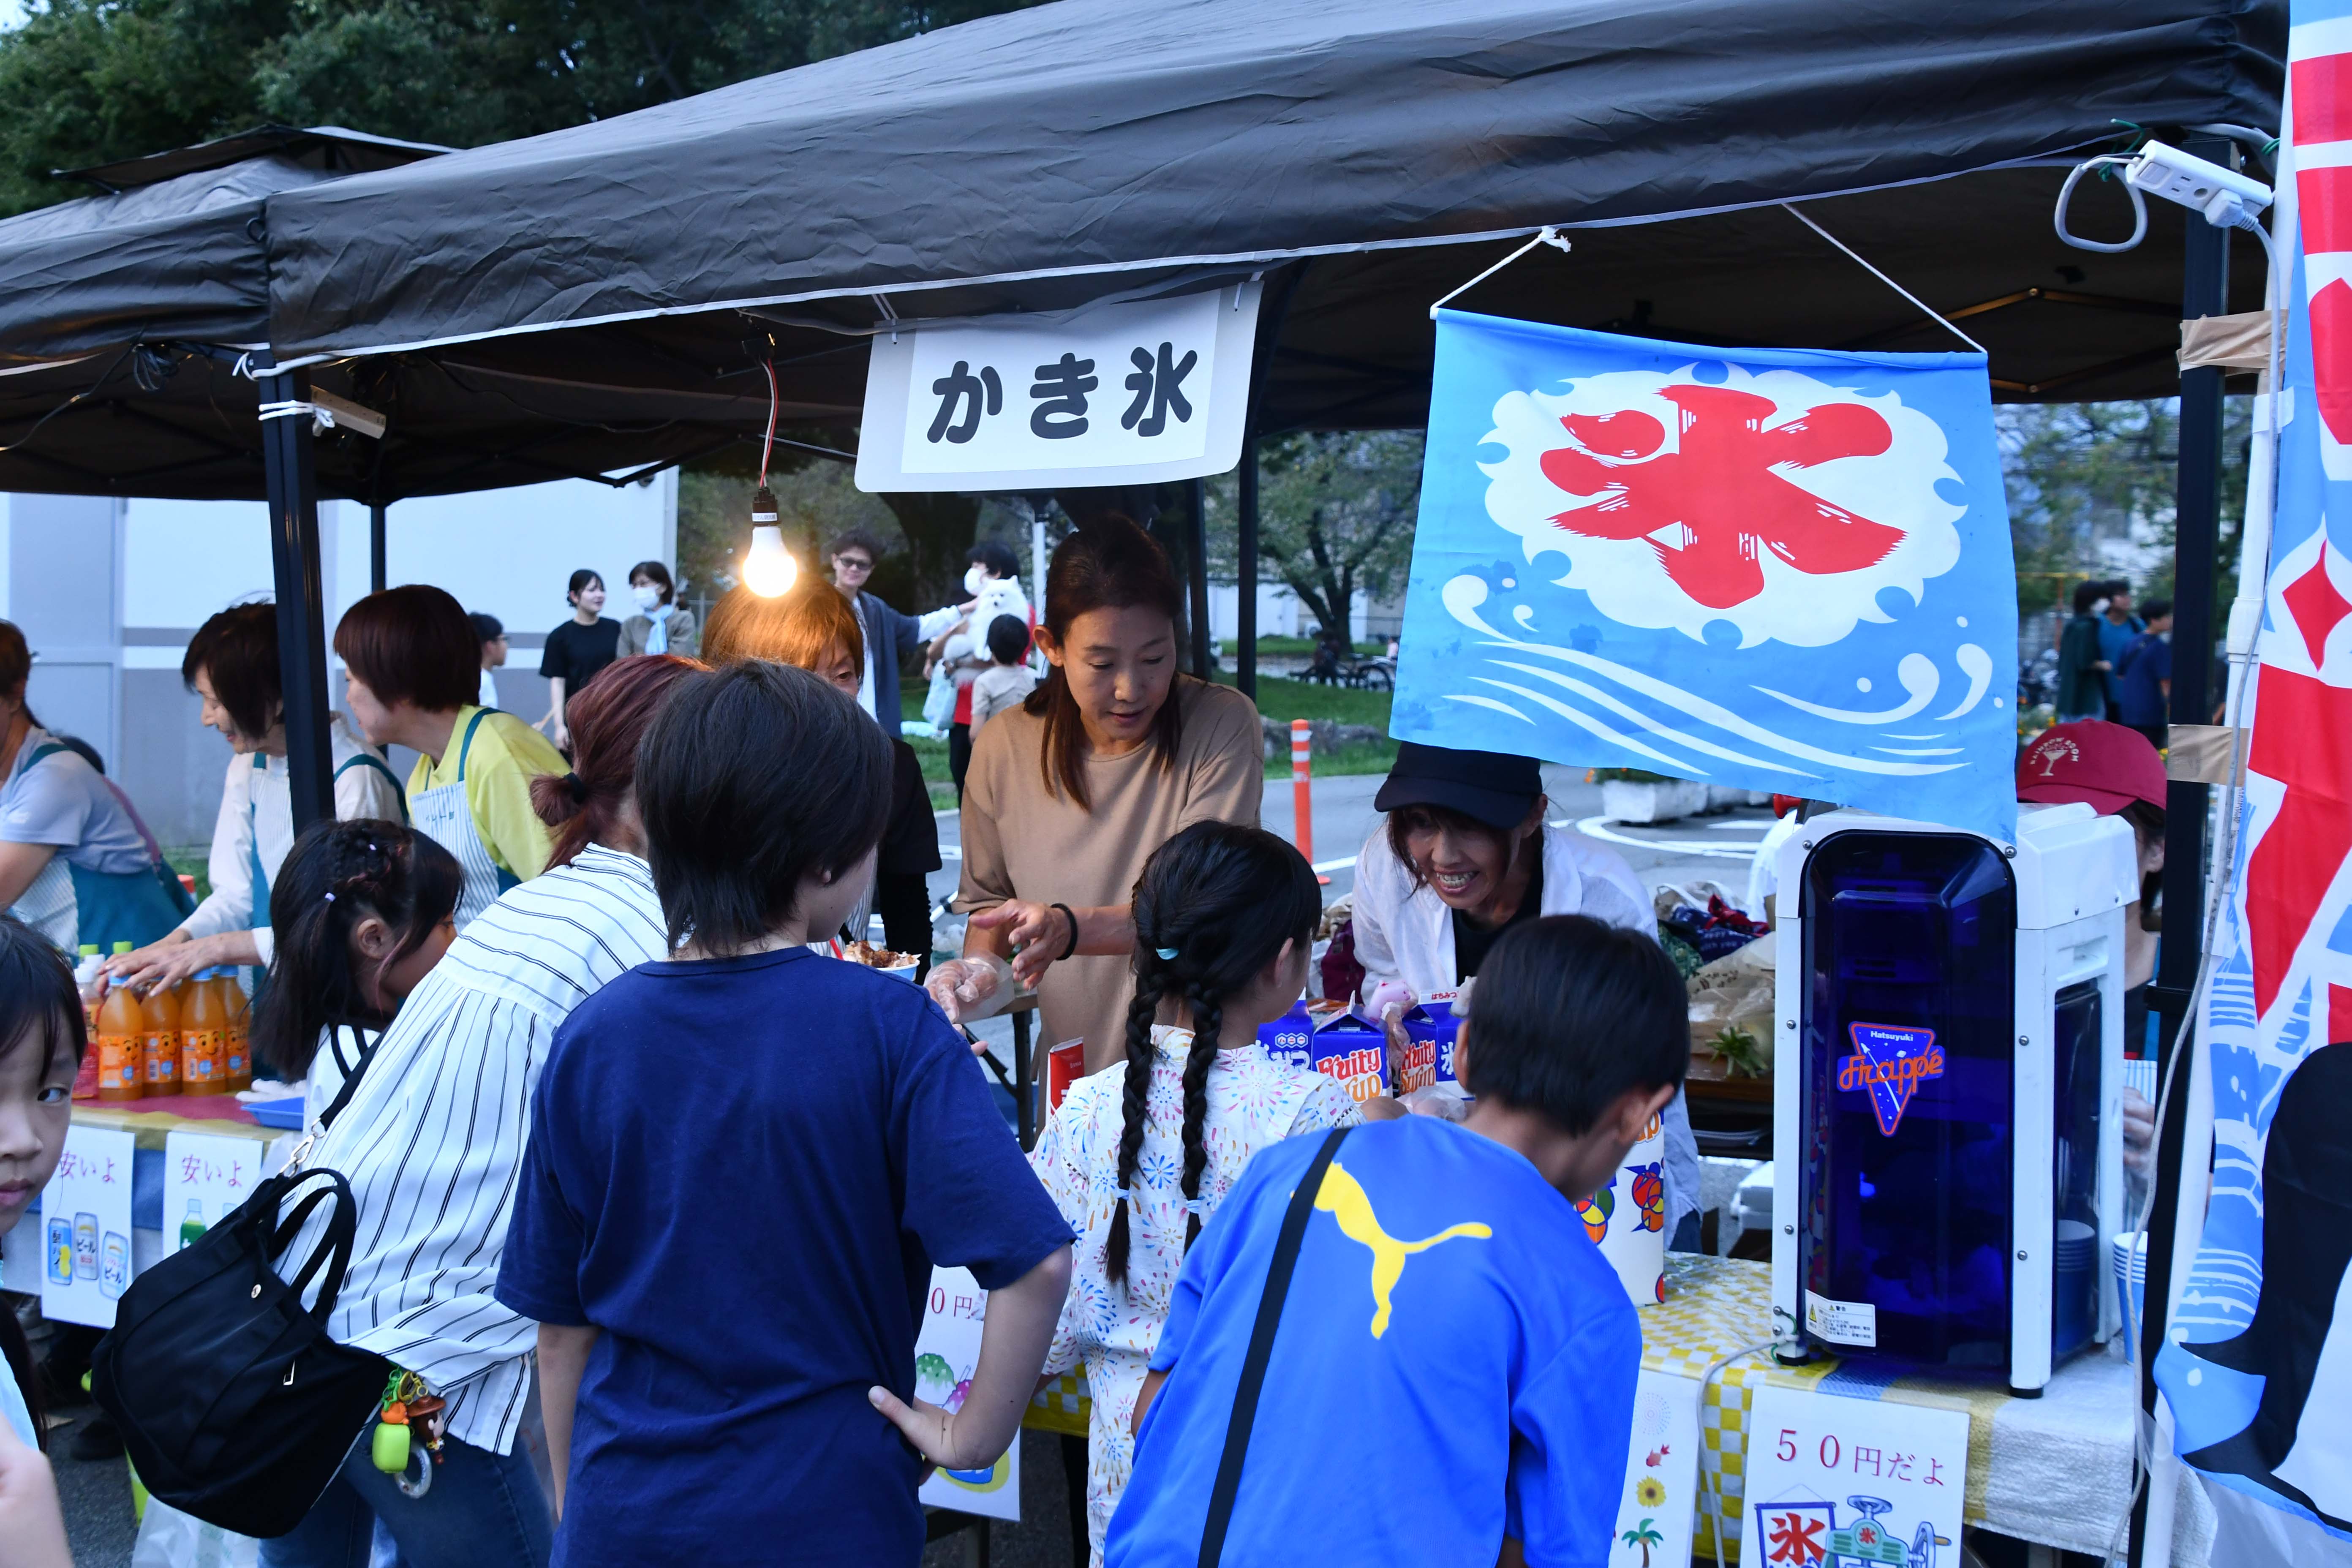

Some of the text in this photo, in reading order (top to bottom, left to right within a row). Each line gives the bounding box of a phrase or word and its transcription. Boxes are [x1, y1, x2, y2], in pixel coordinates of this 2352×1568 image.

[927, 342, 1198, 444] かき氷
[1540, 384, 1910, 609] 氷
[1870, 1030, 1914, 1041] Hatsuyuki
[1317, 1049, 1380, 1081] Fruity
[1839, 1048, 1943, 1095] Frappé
[1345, 1074, 1382, 1102] rup
[60, 1150, 115, 1184] 安いよ
[181, 1154, 242, 1187] 安いよ
[77, 1239, 96, 1253] ビール
[105, 1268, 122, 1284] ビール
[1776, 1429, 1944, 1486] 50円だよ
[1768, 1512, 1826, 1565] 氷
[1859, 1527, 1876, 1544] 氷
